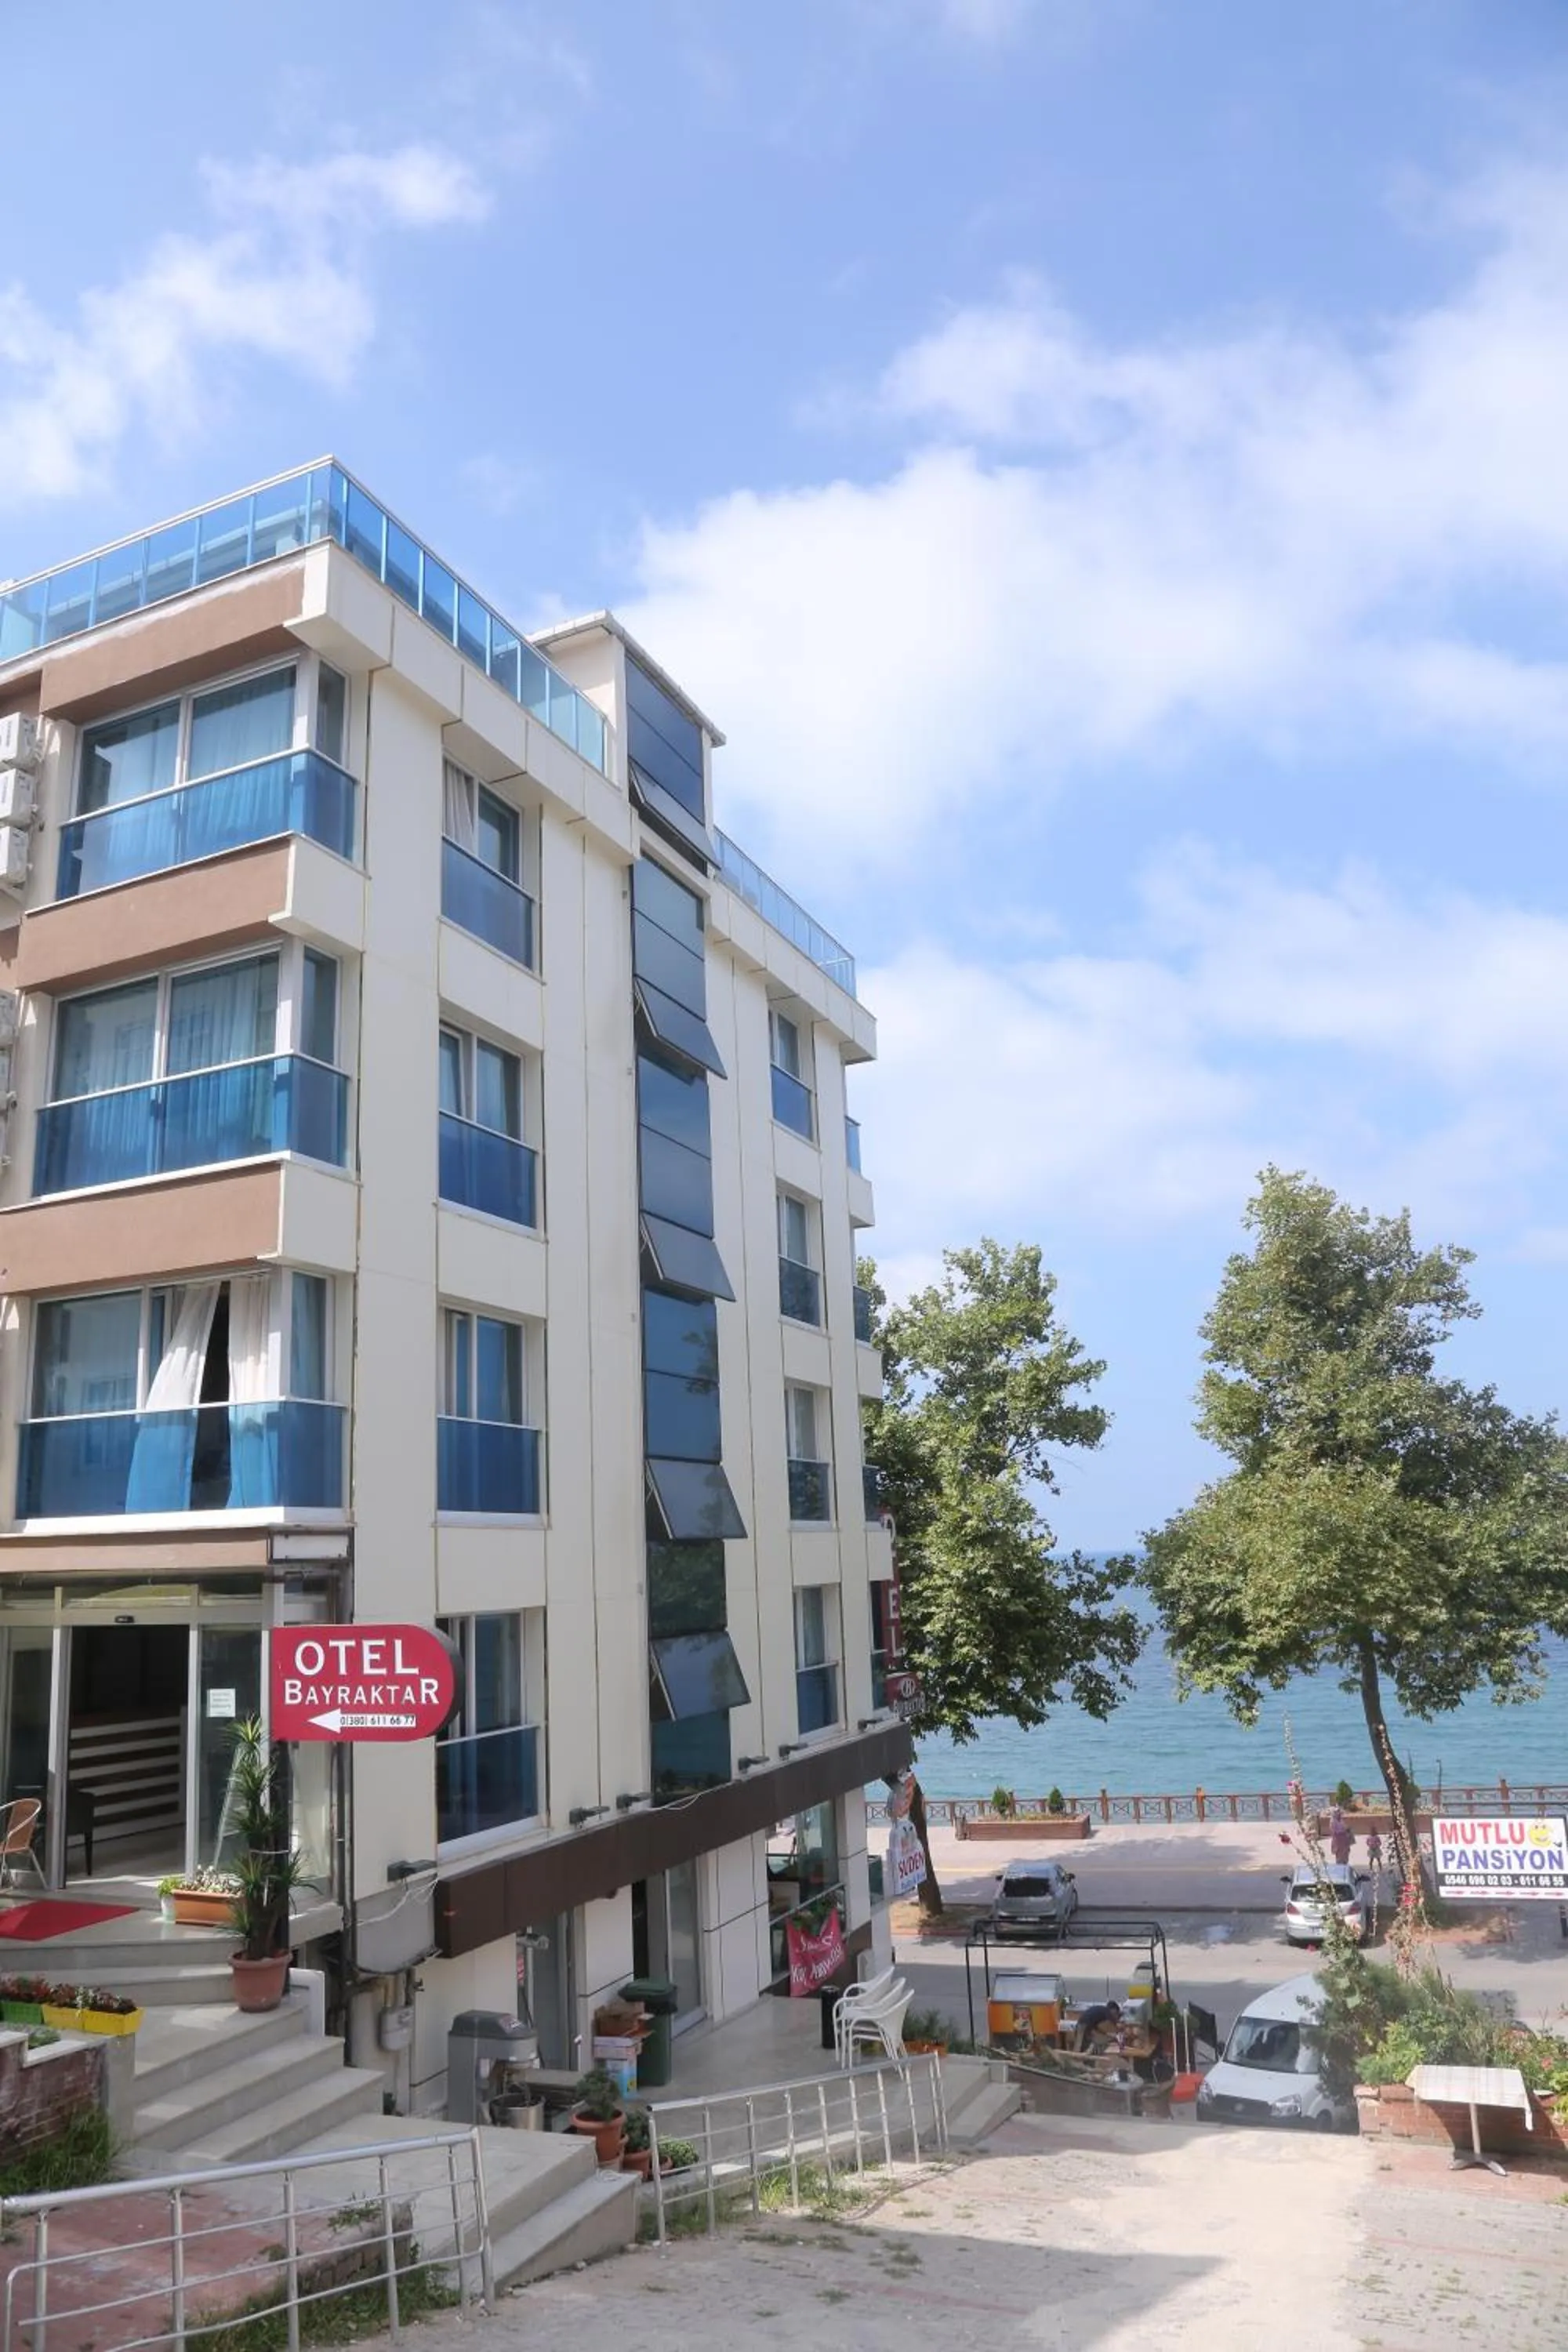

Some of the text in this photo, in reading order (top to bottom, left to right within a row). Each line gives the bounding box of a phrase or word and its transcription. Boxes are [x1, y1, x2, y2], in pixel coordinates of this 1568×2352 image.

[294, 1639, 419, 1675] OTEL
[284, 1678, 440, 1705] BAYRAKTAR
[371, 1715, 387, 1725] 611
[390, 1715, 401, 1726] 66
[404, 1715, 415, 1725] 77
[1439, 1821, 1525, 1845] MUTLU
